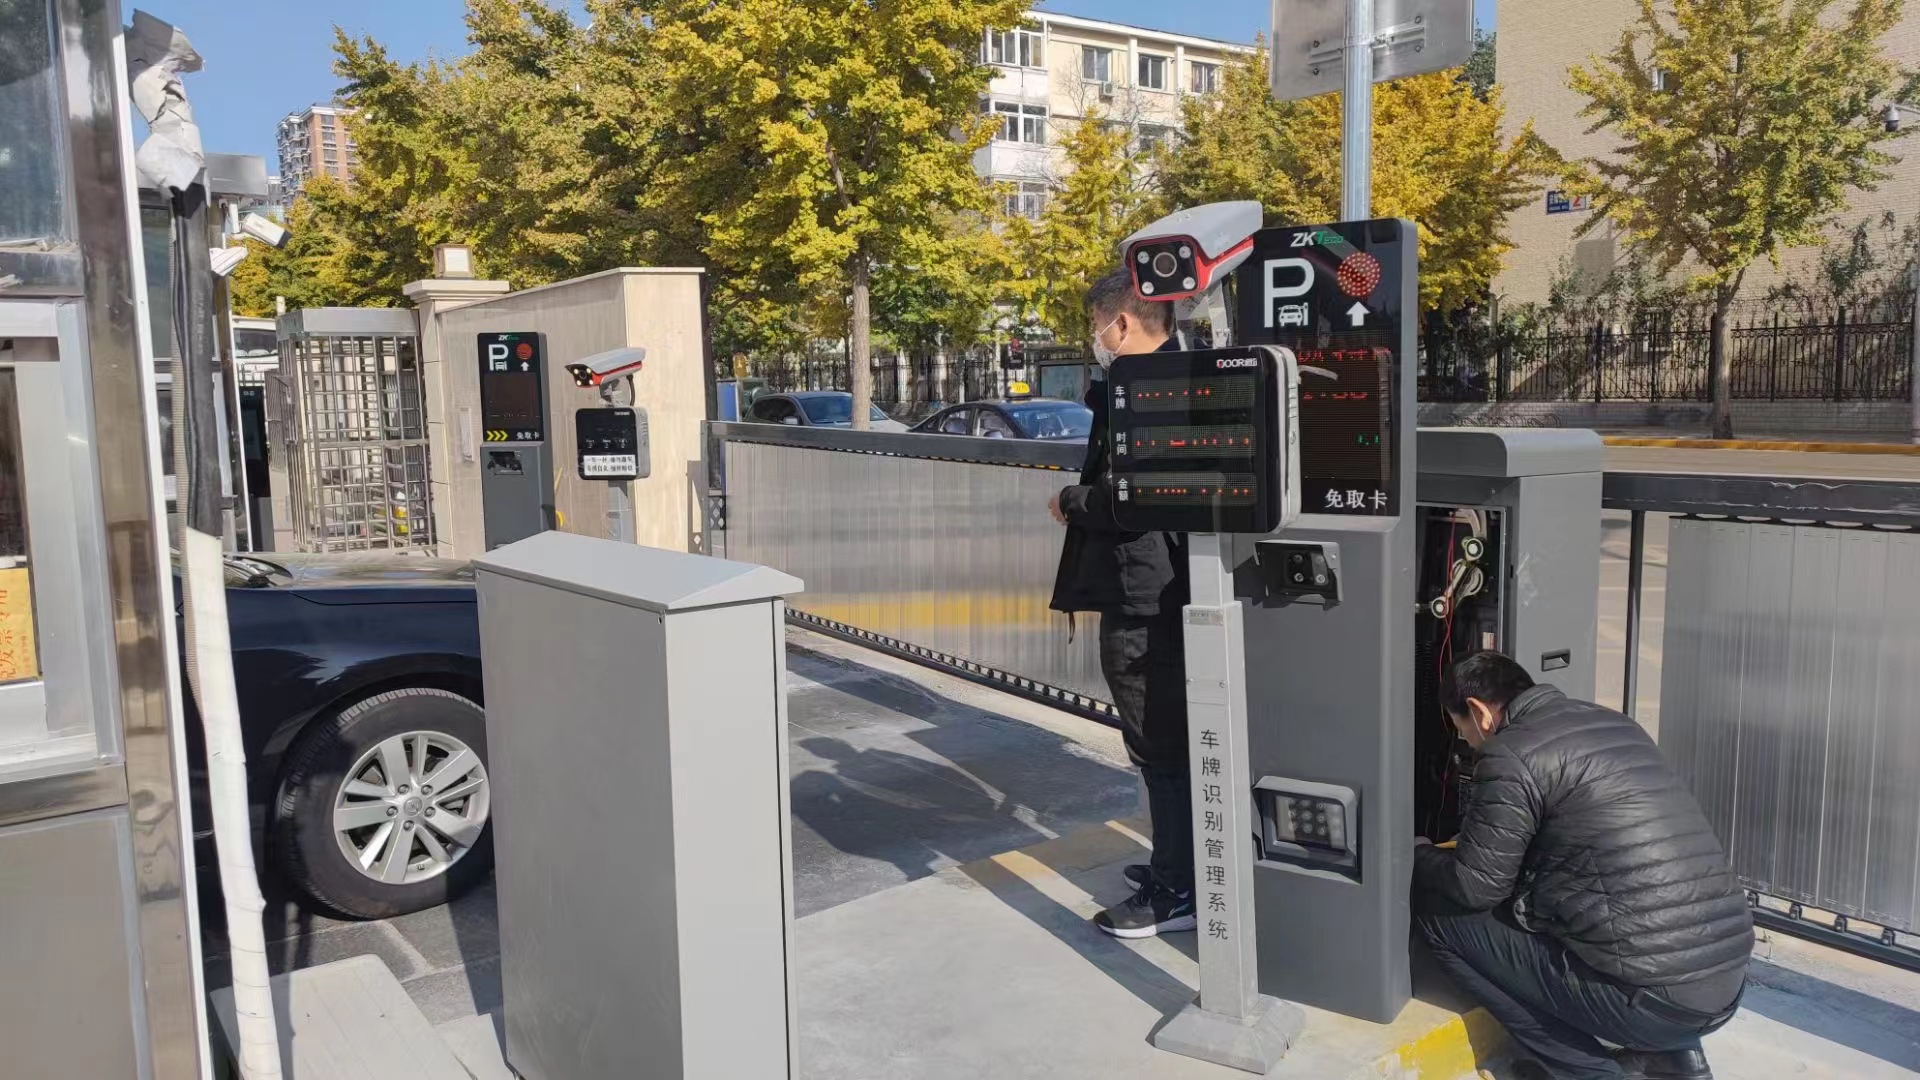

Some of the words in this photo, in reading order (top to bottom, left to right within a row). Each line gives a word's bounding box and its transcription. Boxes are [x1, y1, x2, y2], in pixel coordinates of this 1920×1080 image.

[1264, 258, 1315, 328] P
[488, 344, 509, 371] P
[1114, 385, 1126, 409] 车牌
[1116, 432, 1127, 456] 时间
[1117, 478, 1129, 502] 金额
[1325, 488, 1388, 510] 免取卡
[1199, 729, 1229, 941] 车牌识别管理系统
